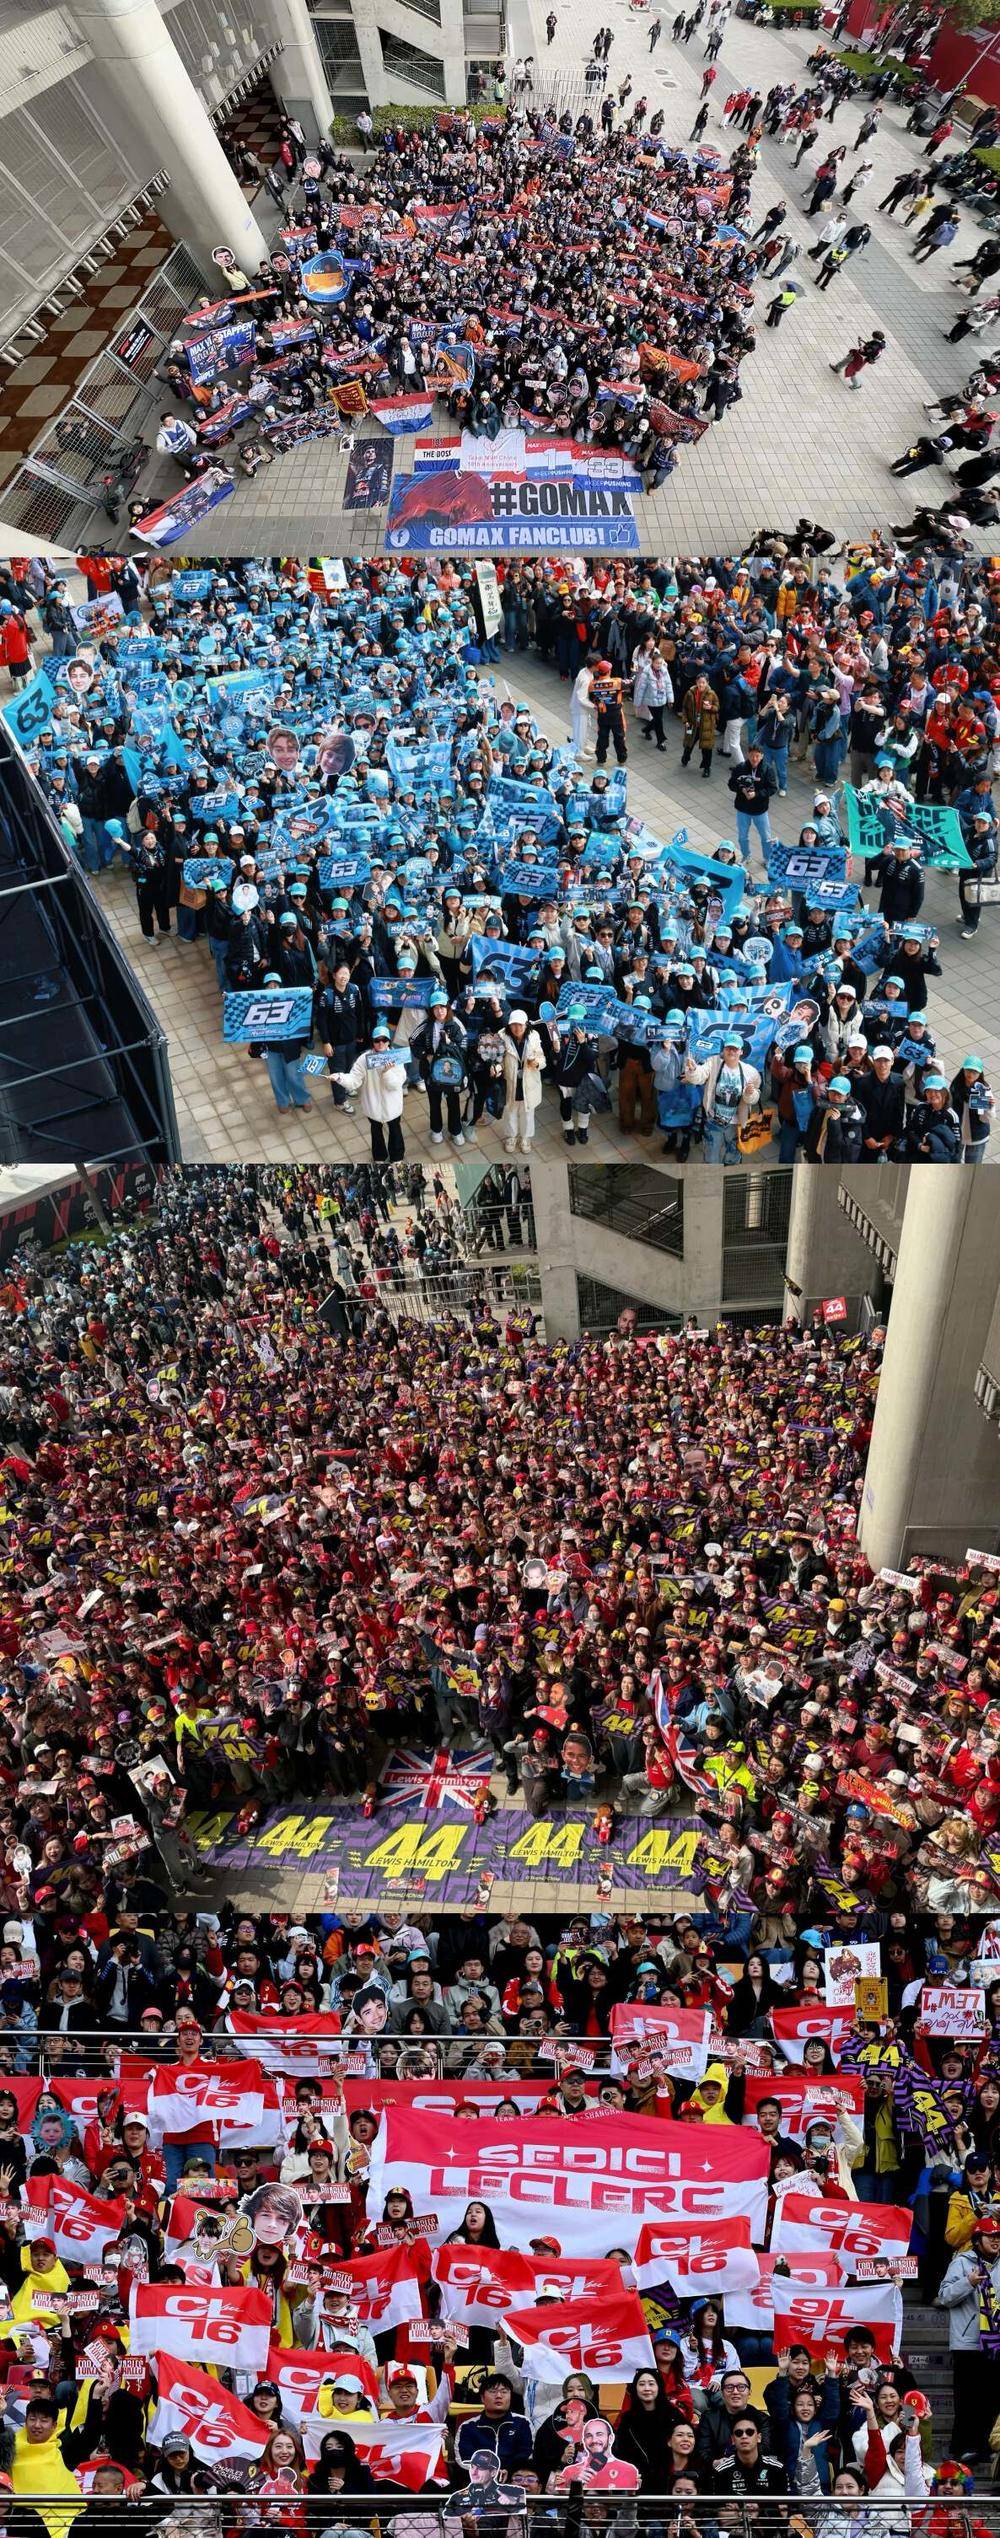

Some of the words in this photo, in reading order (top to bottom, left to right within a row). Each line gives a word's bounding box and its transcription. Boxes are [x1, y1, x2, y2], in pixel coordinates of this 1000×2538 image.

[436, 450, 452, 458] BOSS
[543, 448, 557, 470] 1
[587, 457, 624, 479] 33
[490, 481, 633, 517] #GOMAX
[429, 526, 504, 546] GOMAX
[508, 526, 606, 546] FANCLUB!
[181, 583, 200, 593] 63
[127, 643, 148, 654] 63
[139, 677, 160, 691] 63
[16, 688, 49, 734] 63
[202, 793, 227, 809] 63
[330, 861, 358, 878] 63
[784, 854, 831, 879] 63
[513, 870, 546, 888] 63
[816, 880, 849, 899] 63
[242, 999, 296, 1027] 63
[904, 1045, 922, 1060] 63
[825, 1303, 844, 1313] 44
[157, 1365, 178, 1382] 44
[163, 1425, 182, 1438] 44
[136, 1490, 159, 1507] 44
[27, 1530, 53, 1545] 44
[671, 1521, 696, 1541] 44
[531, 1626, 561, 1643] 44
[601, 1714, 636, 1735] 44
[223, 1742, 258, 1762] 44
[389, 1773, 423, 1785] Lewis
[429, 1773, 484, 1788] Hamilton
[256, 1815, 336, 1858] 44
[261, 1840, 284, 1848] LEWIS
[284, 1840, 323, 1849] HAMILTON
[508, 1821, 586, 1868] 44
[364, 1823, 470, 1881] 44
[370, 1856, 402, 1865] LEWIS
[403, 1857, 457, 1868] HAMILTON
[512, 1849, 538, 1857] LEWIS
[539, 1849, 582, 1858] HAMILTON
[626, 1829, 702, 1877] 44
[630, 1856, 657, 1864] LEWIS
[658, 1857, 693, 1867] HAMILT
[816, 1877, 867, 1912] 44
[940, 1993, 981, 2010] LEW
[174, 2073, 232, 2095] CL
[188, 2091, 243, 2109] 16
[478, 2142, 682, 2178] SEDICI
[429, 2167, 726, 2217] LECLERC
[53, 2187, 90, 2222] CL
[53, 2213, 96, 2242] 16
[809, 2206, 872, 2233] CL
[651, 2235, 711, 2257] CL
[820, 2227, 882, 2256] 16
[448, 2263, 499, 2285] CL
[666, 2251, 728, 2276] 16
[165, 2295, 238, 2320] CL
[457, 2284, 513, 2309] 16
[790, 2298, 855, 2321] 16
[179, 2319, 243, 2345] 16
[538, 2323, 607, 2350] CL
[553, 2339, 624, 2371] 16
[167, 2381, 232, 2425] CL
[176, 2408, 238, 2449] 16
[213, 2463, 244, 2477] CHARLES
[213, 2469, 242, 2483] LECLERC
